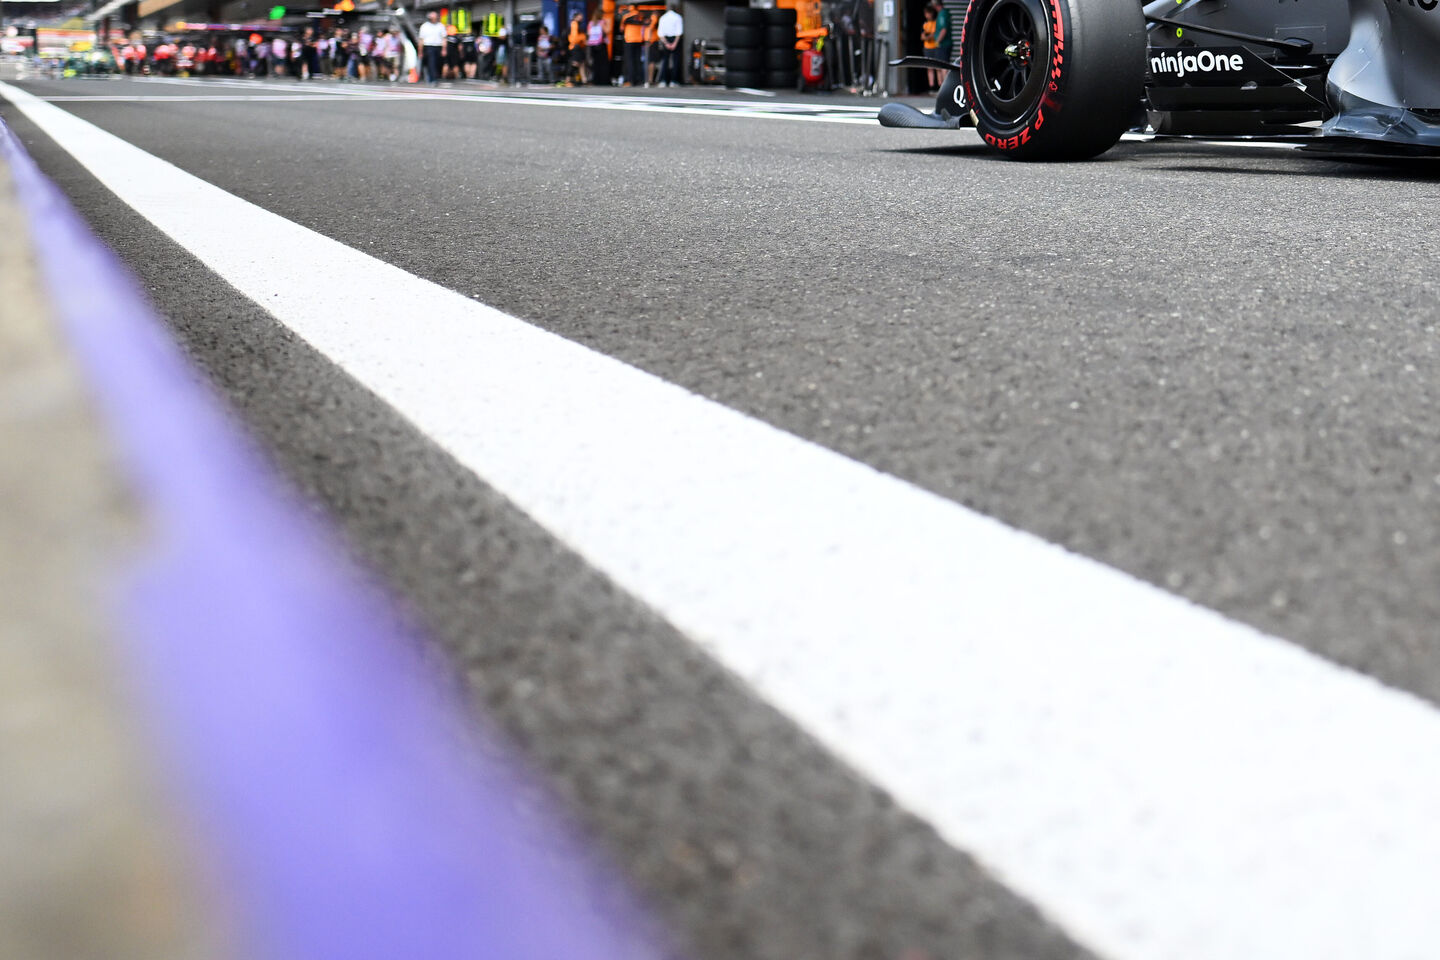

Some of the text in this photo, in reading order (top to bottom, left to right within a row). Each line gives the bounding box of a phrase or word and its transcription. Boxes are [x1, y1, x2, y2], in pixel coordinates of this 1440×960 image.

[1151, 50, 1244, 77] ninjaOne
[953, 85, 967, 108] Q
[984, 108, 1045, 150] P ZERO
